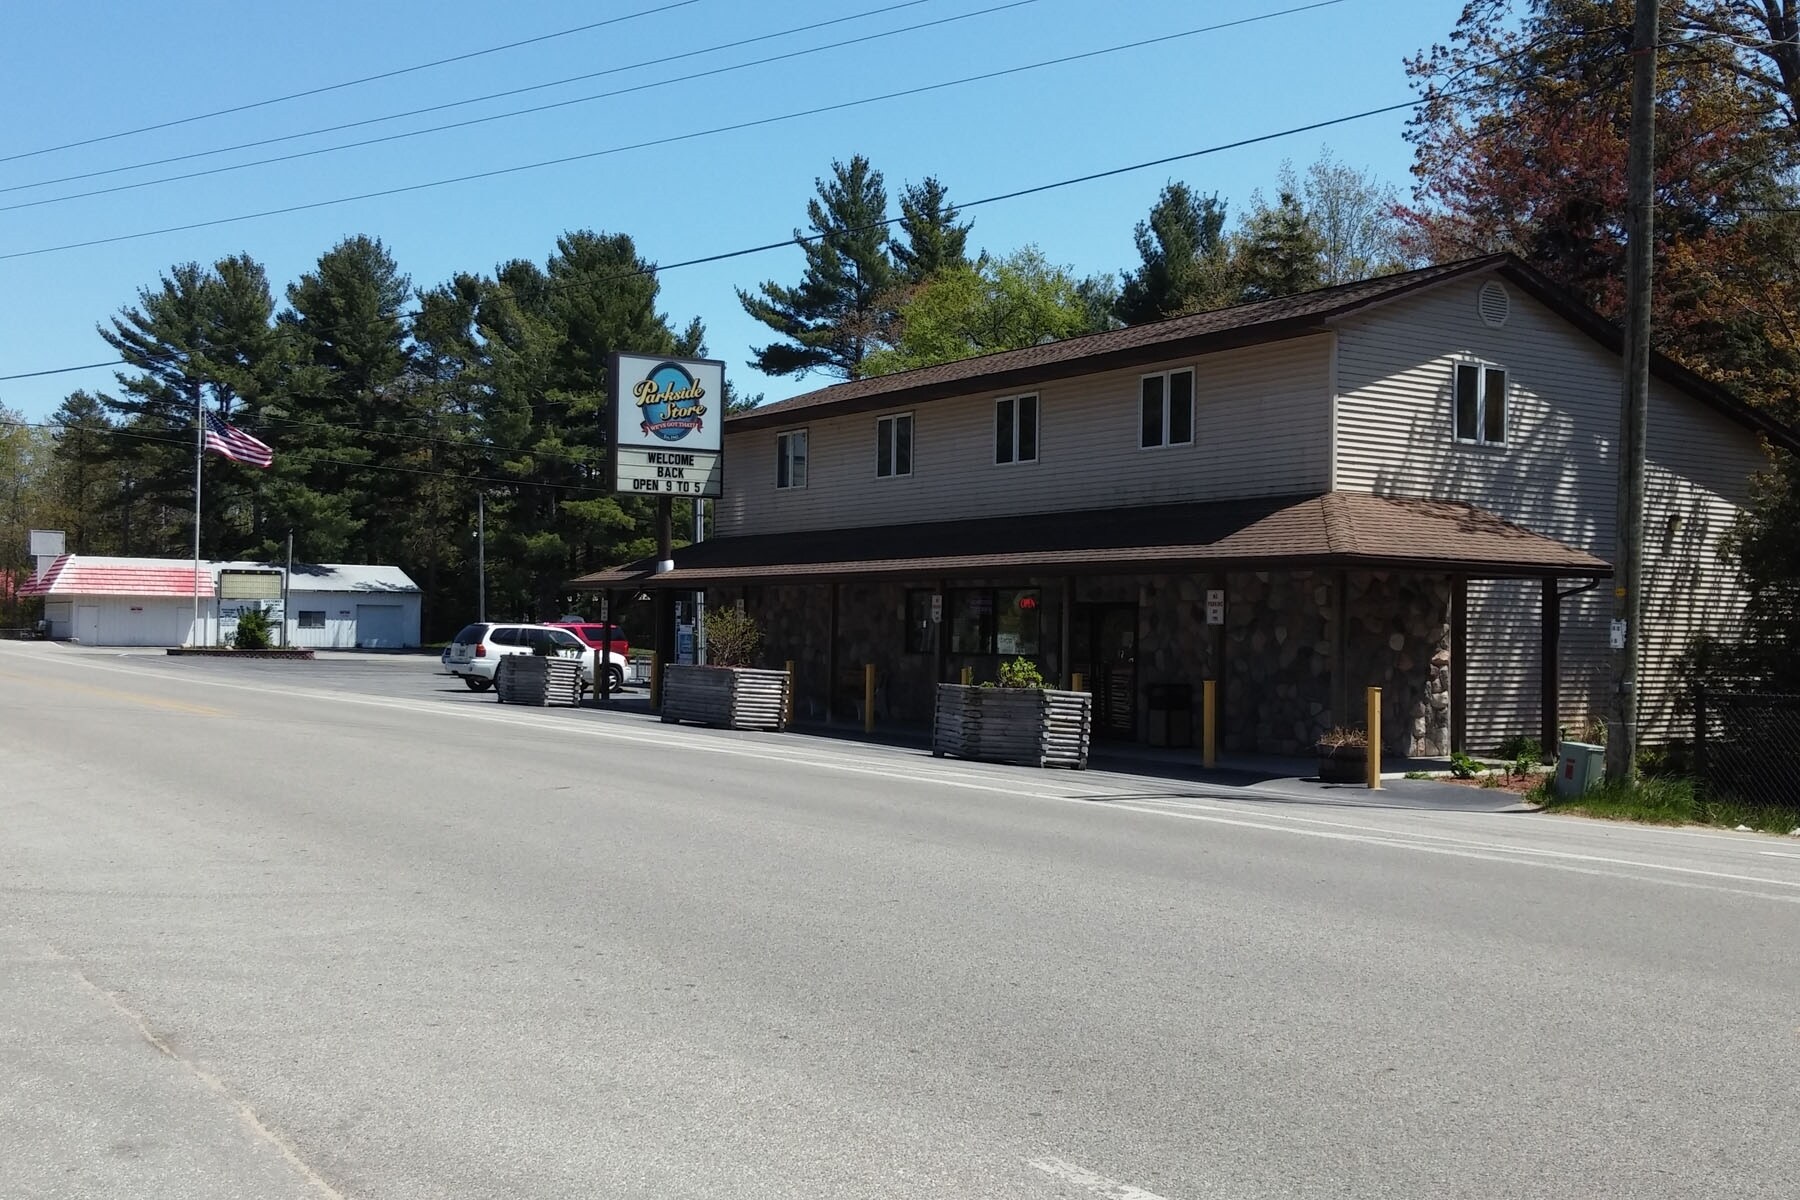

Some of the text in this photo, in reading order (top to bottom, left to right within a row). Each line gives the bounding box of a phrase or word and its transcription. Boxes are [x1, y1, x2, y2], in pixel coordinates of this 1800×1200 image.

[633, 378, 705, 406] Parkside
[660, 402, 707, 421] Store
[648, 453, 694, 466] WELCOME
[657, 467, 684, 478] BACK
[633, 478, 700, 493] OPEN 9 TO 5
[1019, 598, 1036, 609] OPEN
